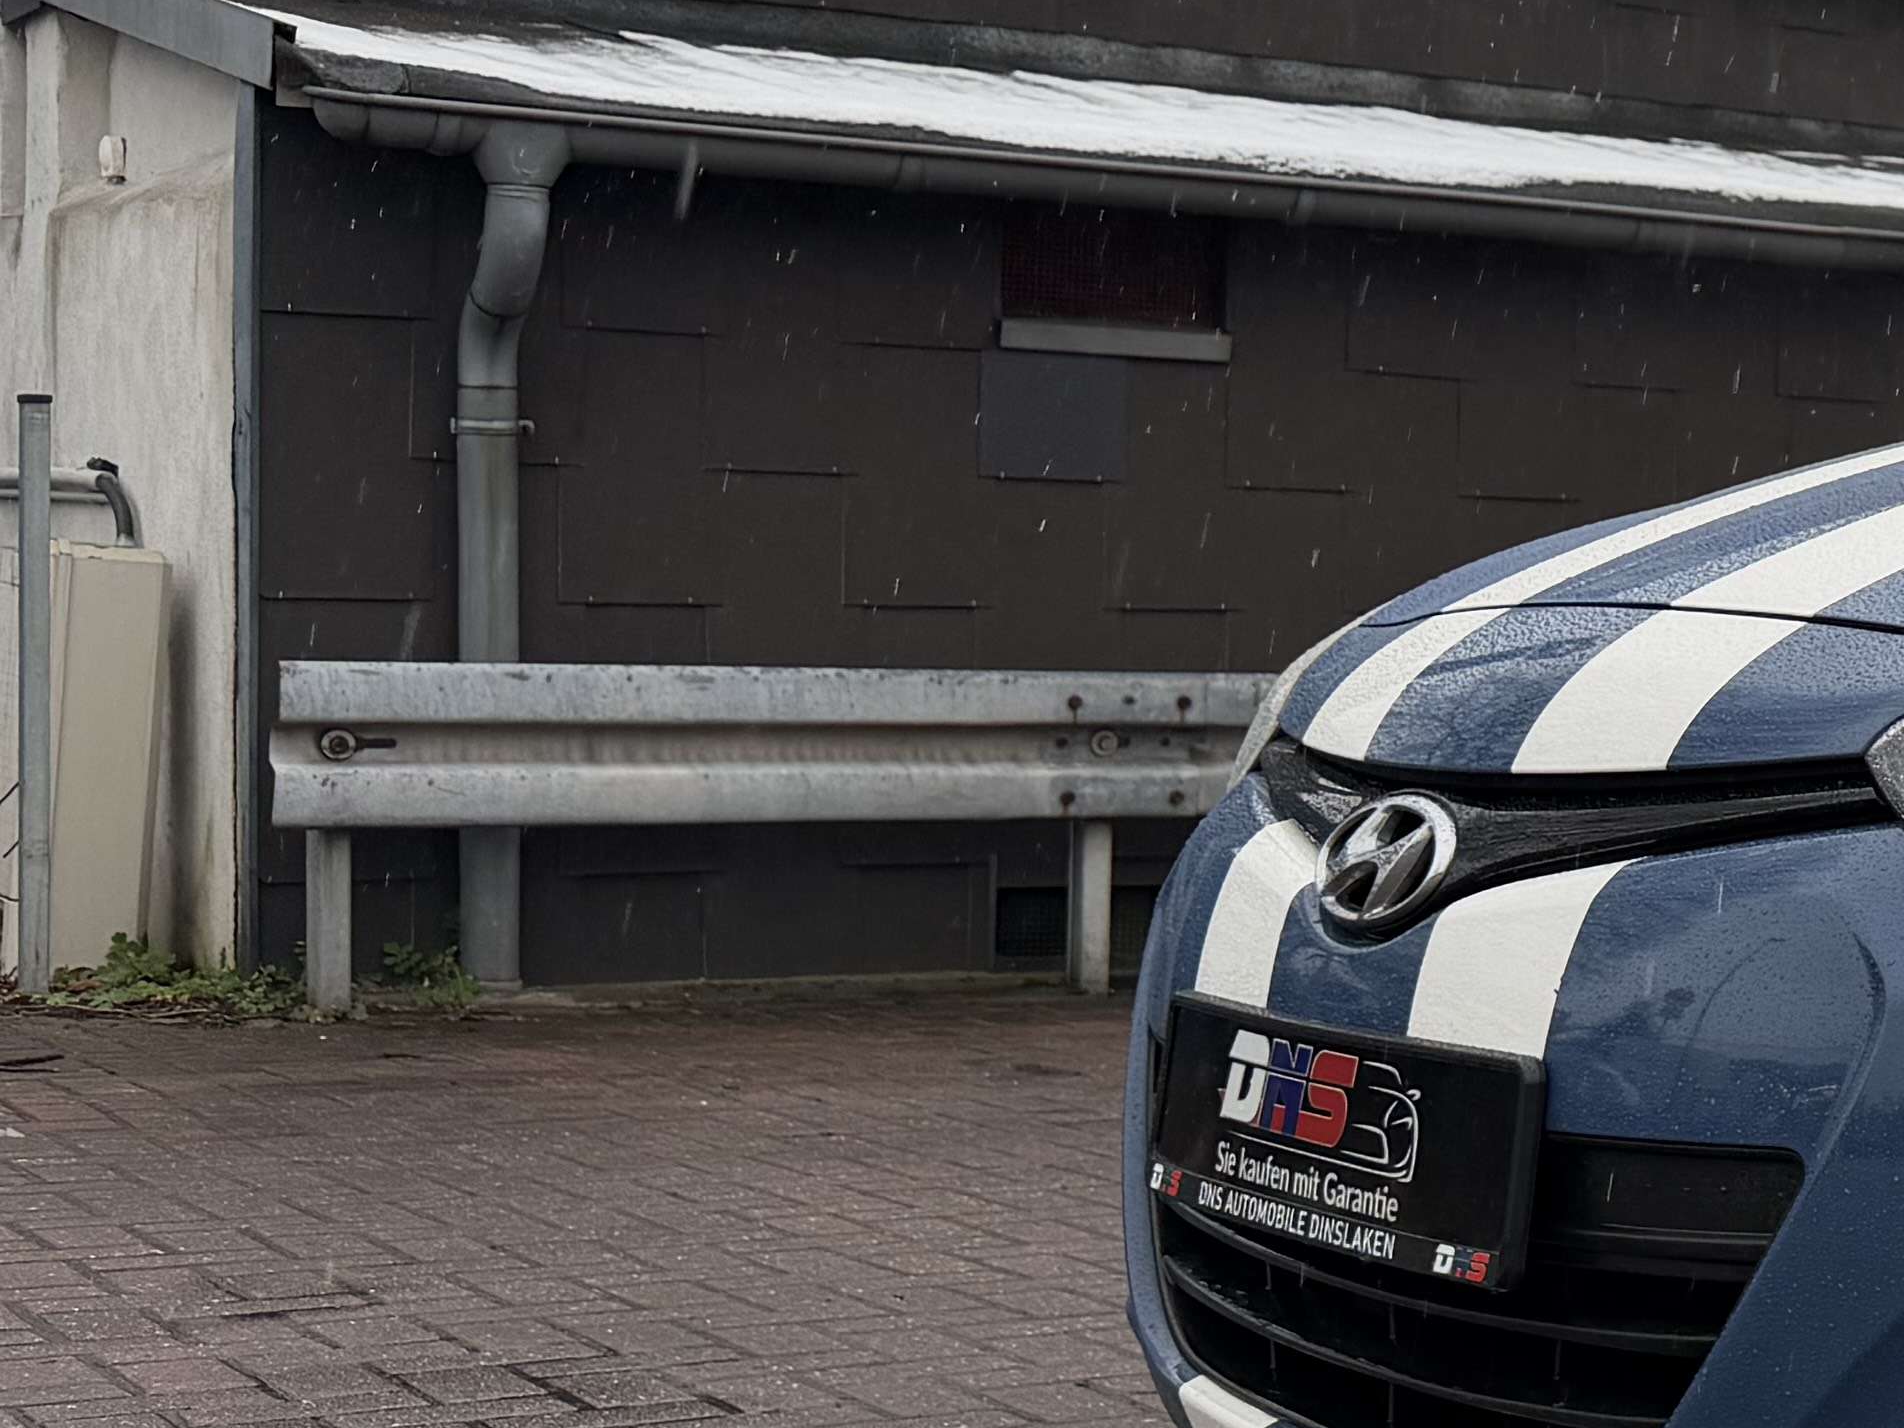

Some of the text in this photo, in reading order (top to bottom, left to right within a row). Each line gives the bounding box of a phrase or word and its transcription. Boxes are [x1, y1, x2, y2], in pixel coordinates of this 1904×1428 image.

[1218, 1028, 1361, 1149] DNS
[1198, 1180, 1397, 1261] DNS AUTOMOBILE DINSLAKEN
[1214, 1140, 1400, 1222] Sie kaufen mit Garantie
